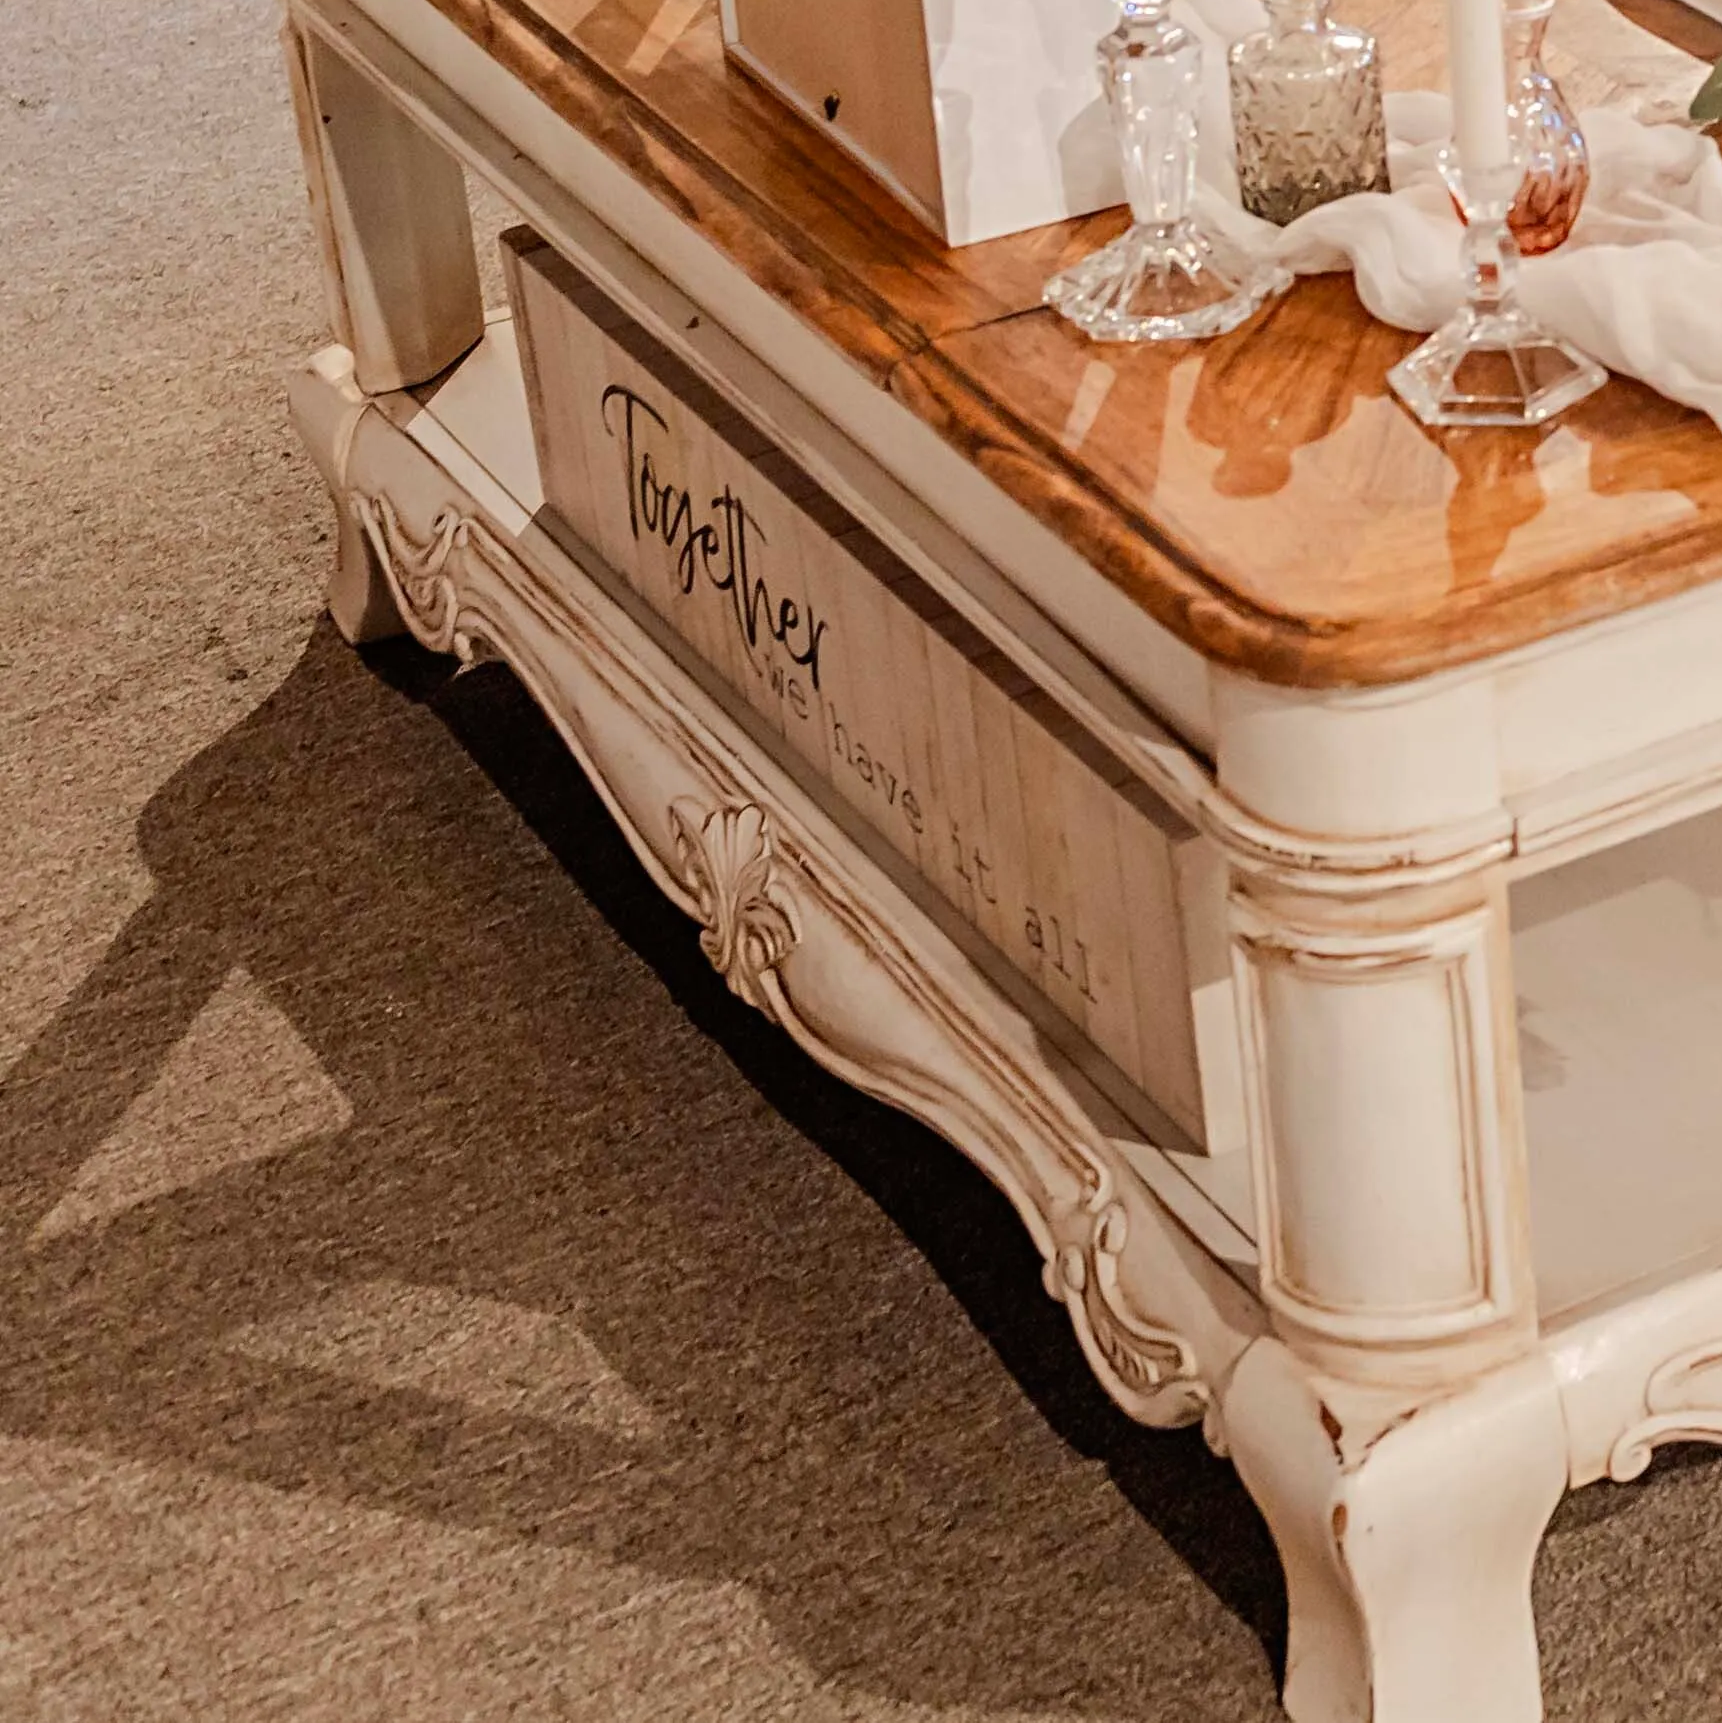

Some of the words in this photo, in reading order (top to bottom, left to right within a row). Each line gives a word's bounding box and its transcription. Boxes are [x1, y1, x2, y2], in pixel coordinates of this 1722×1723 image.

[601, 384, 830, 693] Together
[764, 653, 808, 719] we
[828, 701, 923, 835] have
[952, 822, 997, 904] it
[1025, 906, 1098, 1005] all
